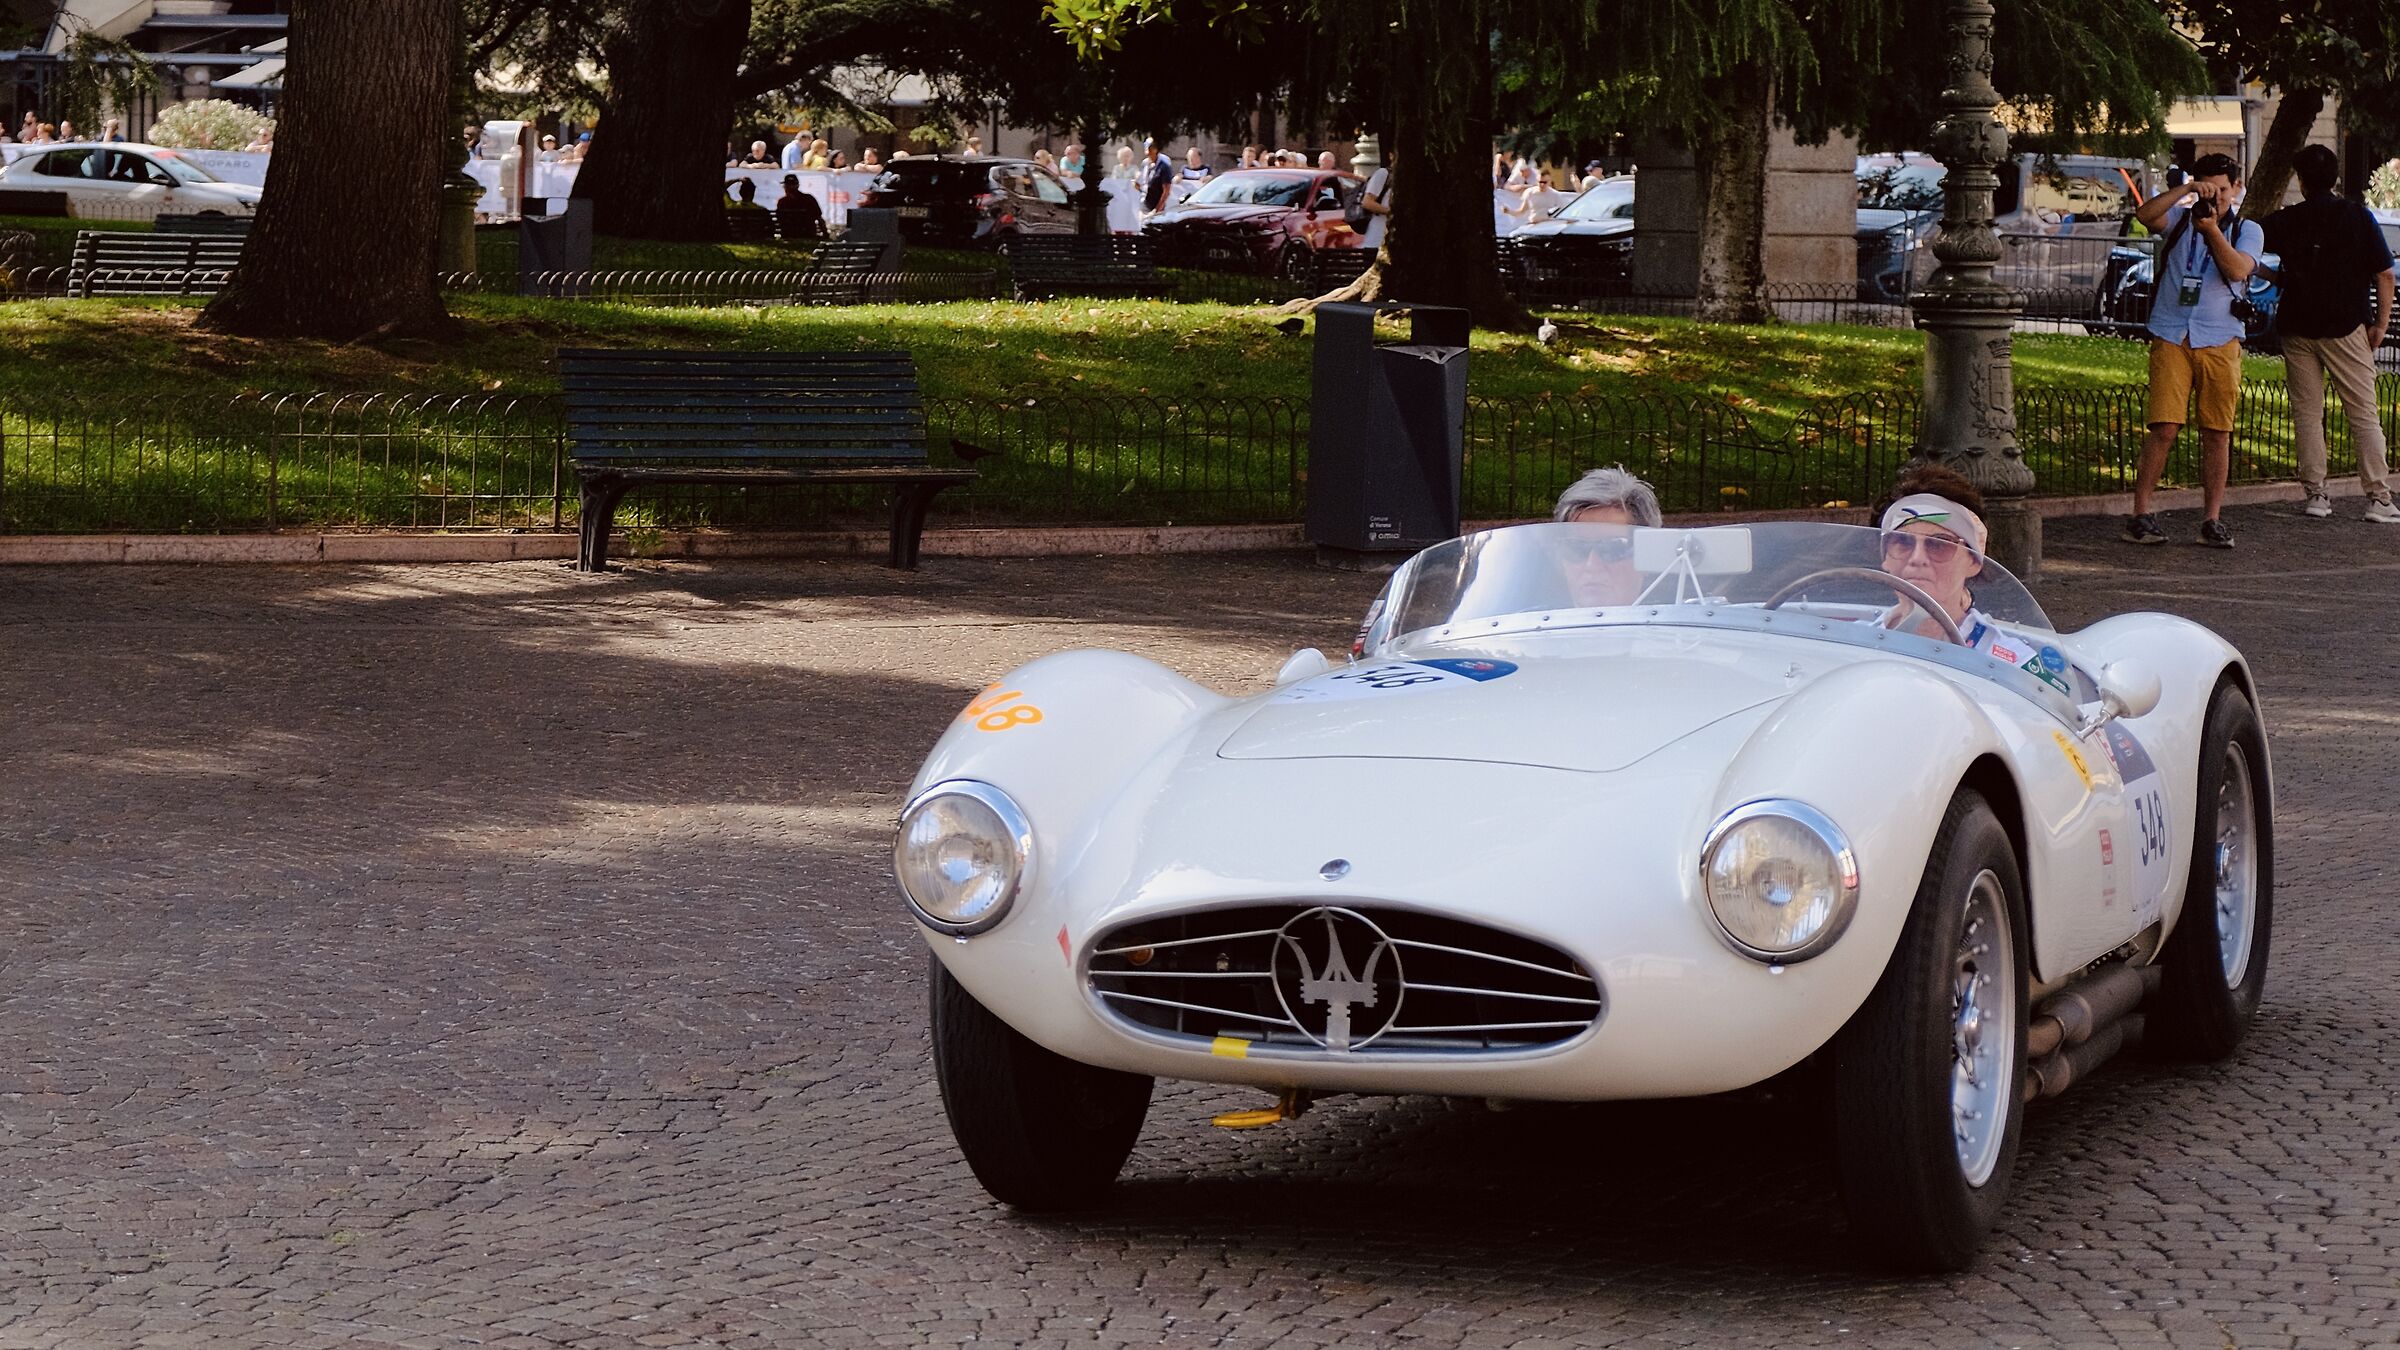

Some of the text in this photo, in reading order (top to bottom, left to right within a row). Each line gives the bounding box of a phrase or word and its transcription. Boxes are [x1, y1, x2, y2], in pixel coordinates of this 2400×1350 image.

[1331, 666, 1444, 688] 348
[964, 682, 1044, 732] 48
[2135, 790, 2165, 866] 348
